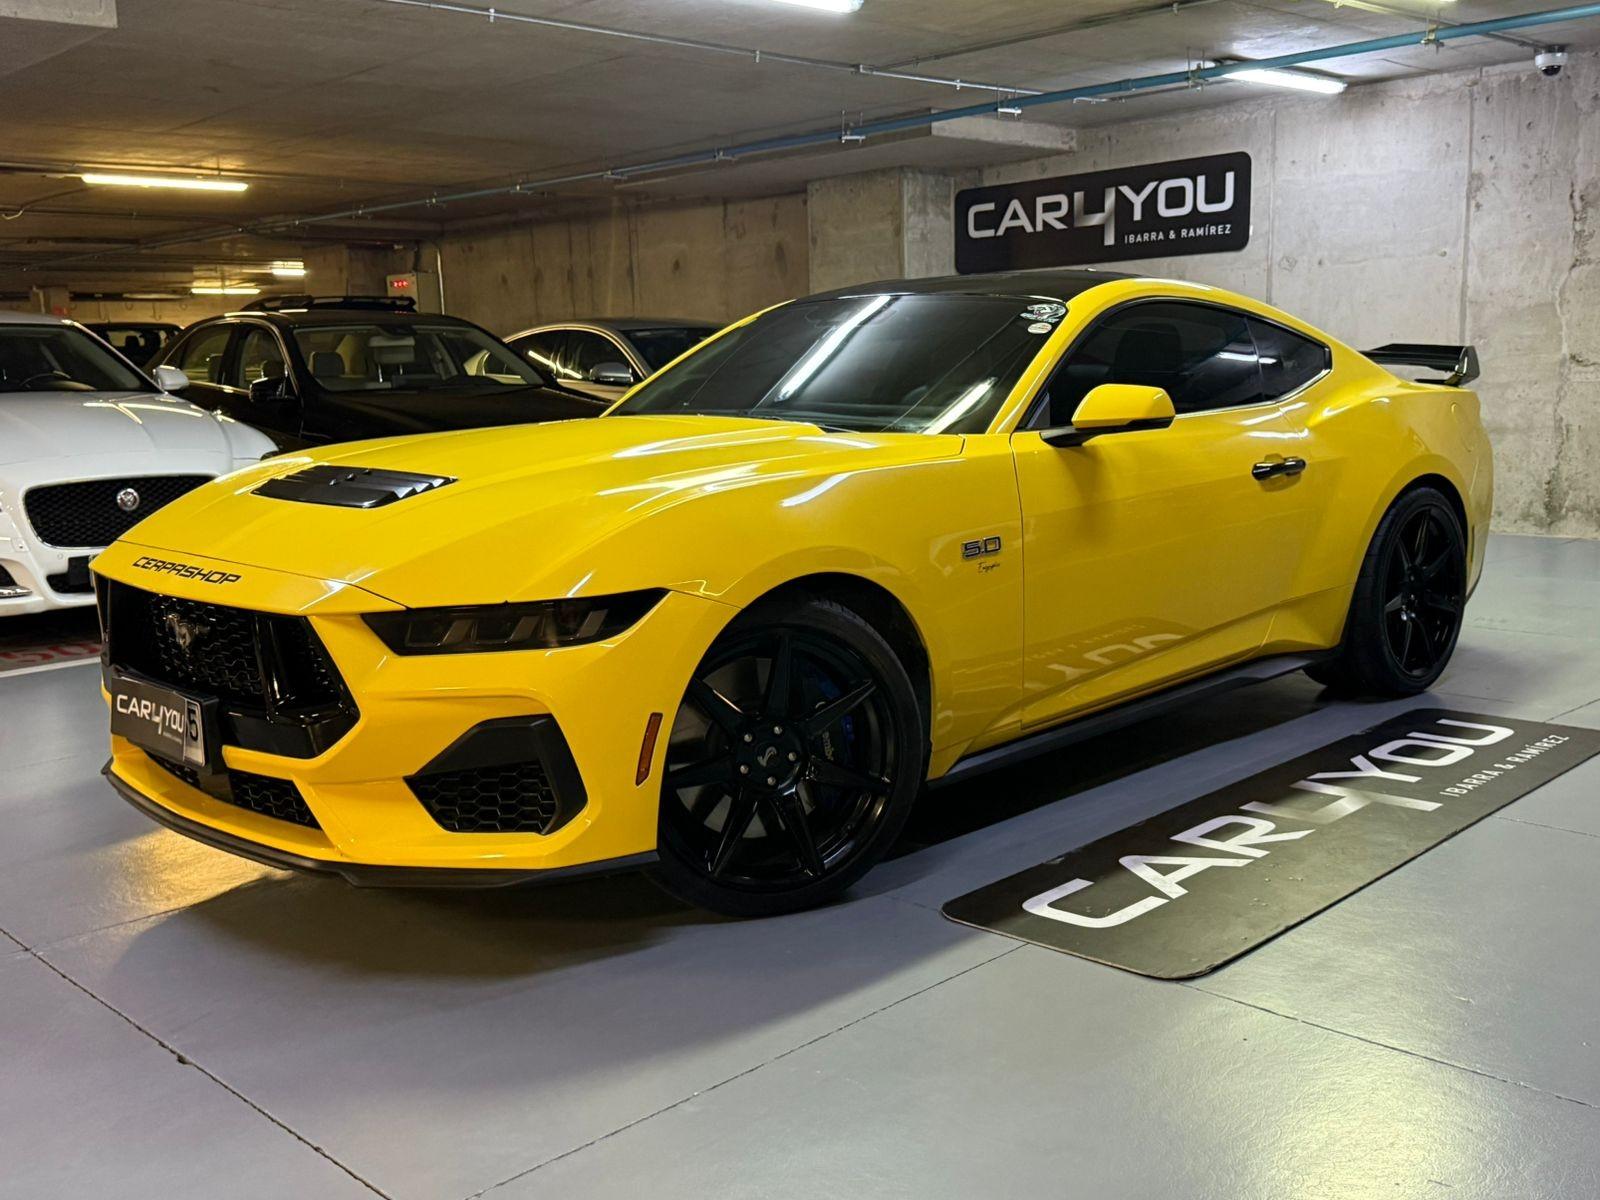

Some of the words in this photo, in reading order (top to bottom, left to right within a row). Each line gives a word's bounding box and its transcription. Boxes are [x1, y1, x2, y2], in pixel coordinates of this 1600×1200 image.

[967, 171, 1235, 246] CAR4YOU
[1124, 231, 1165, 244] IBARRA
[1168, 230, 1176, 240] &
[1181, 224, 1232, 239] RAMÍREZ
[961, 536, 1001, 560] 5.0
[132, 556, 242, 584] CERPASHOP
[116, 694, 185, 735] CAR4YOU
[1439, 770, 1503, 797] IBARRA
[1506, 735, 1570, 763] RAMÍREZ
[1021, 718, 1515, 929] CAR4YOU
